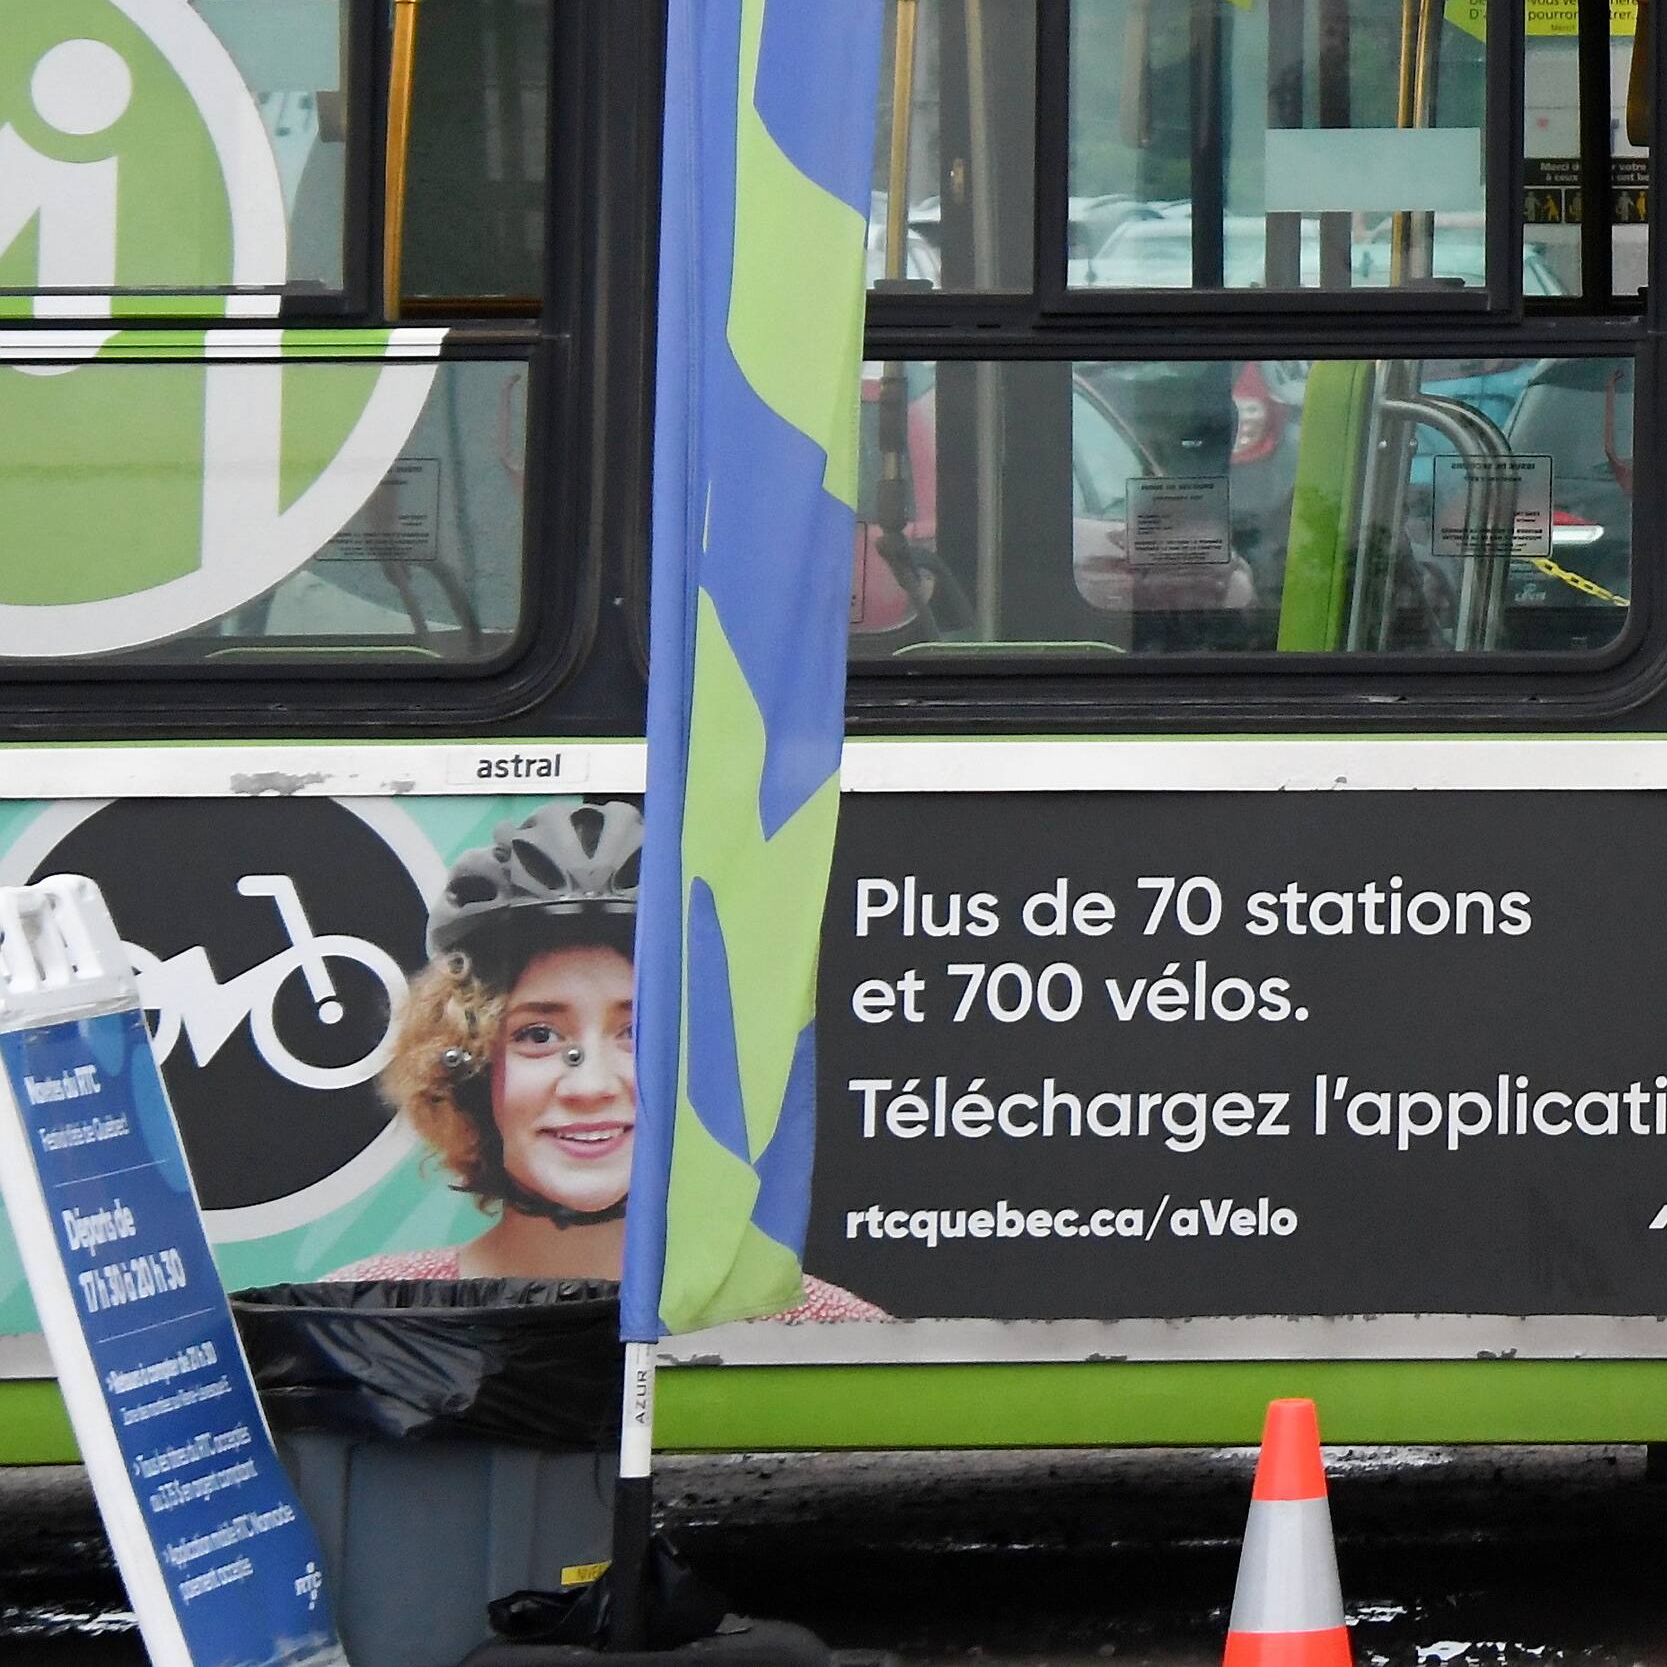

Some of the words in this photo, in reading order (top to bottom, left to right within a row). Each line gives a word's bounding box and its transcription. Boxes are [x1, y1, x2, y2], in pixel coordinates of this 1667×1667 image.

[476, 753, 562, 779] astral
[855, 875, 1000, 938] Plus
[1021, 877, 1118, 937] de
[1136, 876, 1223, 936] 70
[1245, 875, 1533, 936] stations
[851, 969, 926, 1023] et
[946, 962, 1084, 1023] 700
[1104, 960, 1311, 1023] vélos.
[847, 1075, 1291, 1153] Téléchargez
[114, 1197, 137, 1238] de
[846, 1194, 1299, 1248] rtcquebec.ca/aVelo
[160, 1246, 187, 1289] 30
[635, 1369, 648, 1424] AZUR
